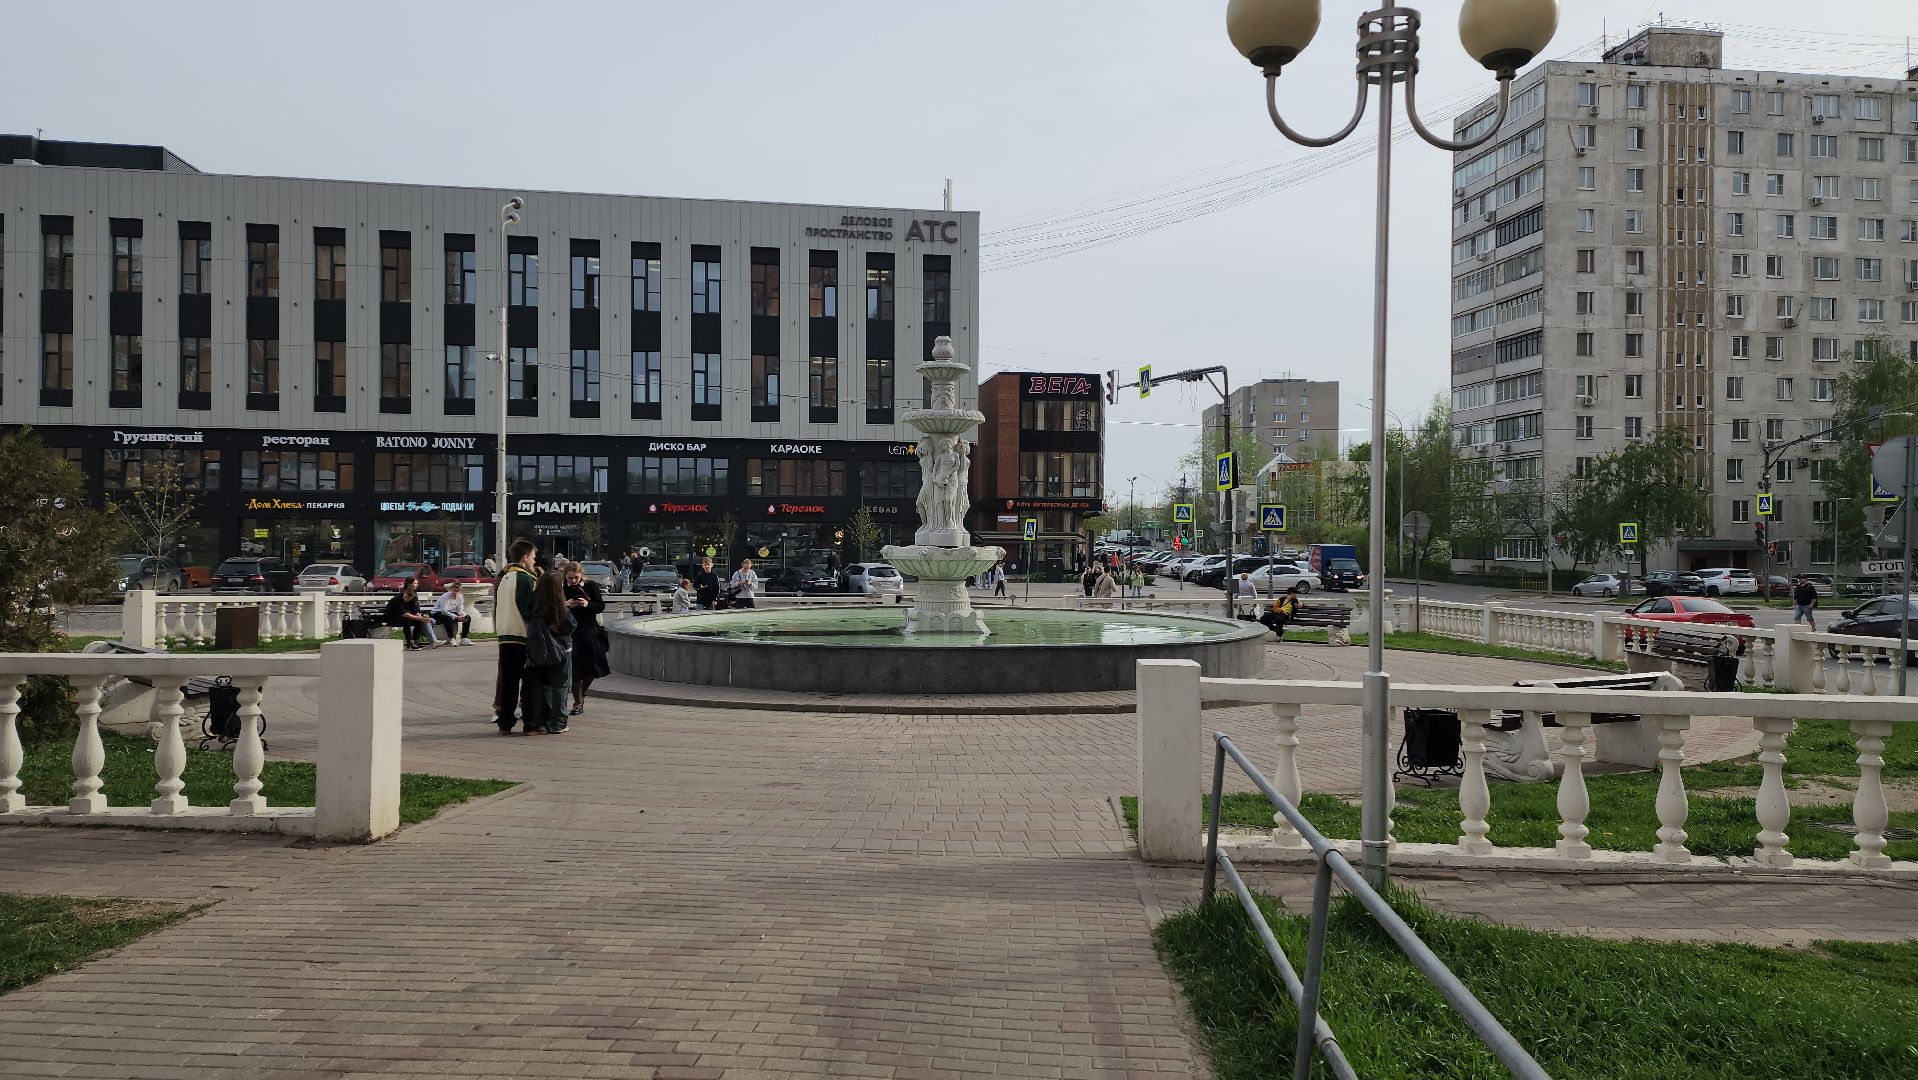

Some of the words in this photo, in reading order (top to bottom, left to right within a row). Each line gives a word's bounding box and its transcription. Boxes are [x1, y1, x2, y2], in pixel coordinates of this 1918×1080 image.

[841, 216, 893, 227] ДЕЛОВОЕ
[805, 227, 893, 241] ПРОСТРАНСТВО
[905, 219, 958, 243] АТС
[1029, 376, 1091, 395] ВЕГА
[113, 431, 204, 445] Грузинский
[262, 435, 330, 447] ресторан
[375, 436, 428, 448] BATONO
[431, 437, 476, 449] JONNY
[648, 442, 685, 452] ДИСКО
[686, 443, 707, 452] БАР
[770, 444, 823, 455] КАРАОКЕ
[248, 498, 271, 510] Дом
[380, 502, 405, 512] ЦВЕТЫ
[536, 501, 602, 514] МАГНИТ
[662, 502, 709, 513] Теремок
[779, 503, 825, 514] Теремок
[1868, 561, 1904, 572] СТОП
